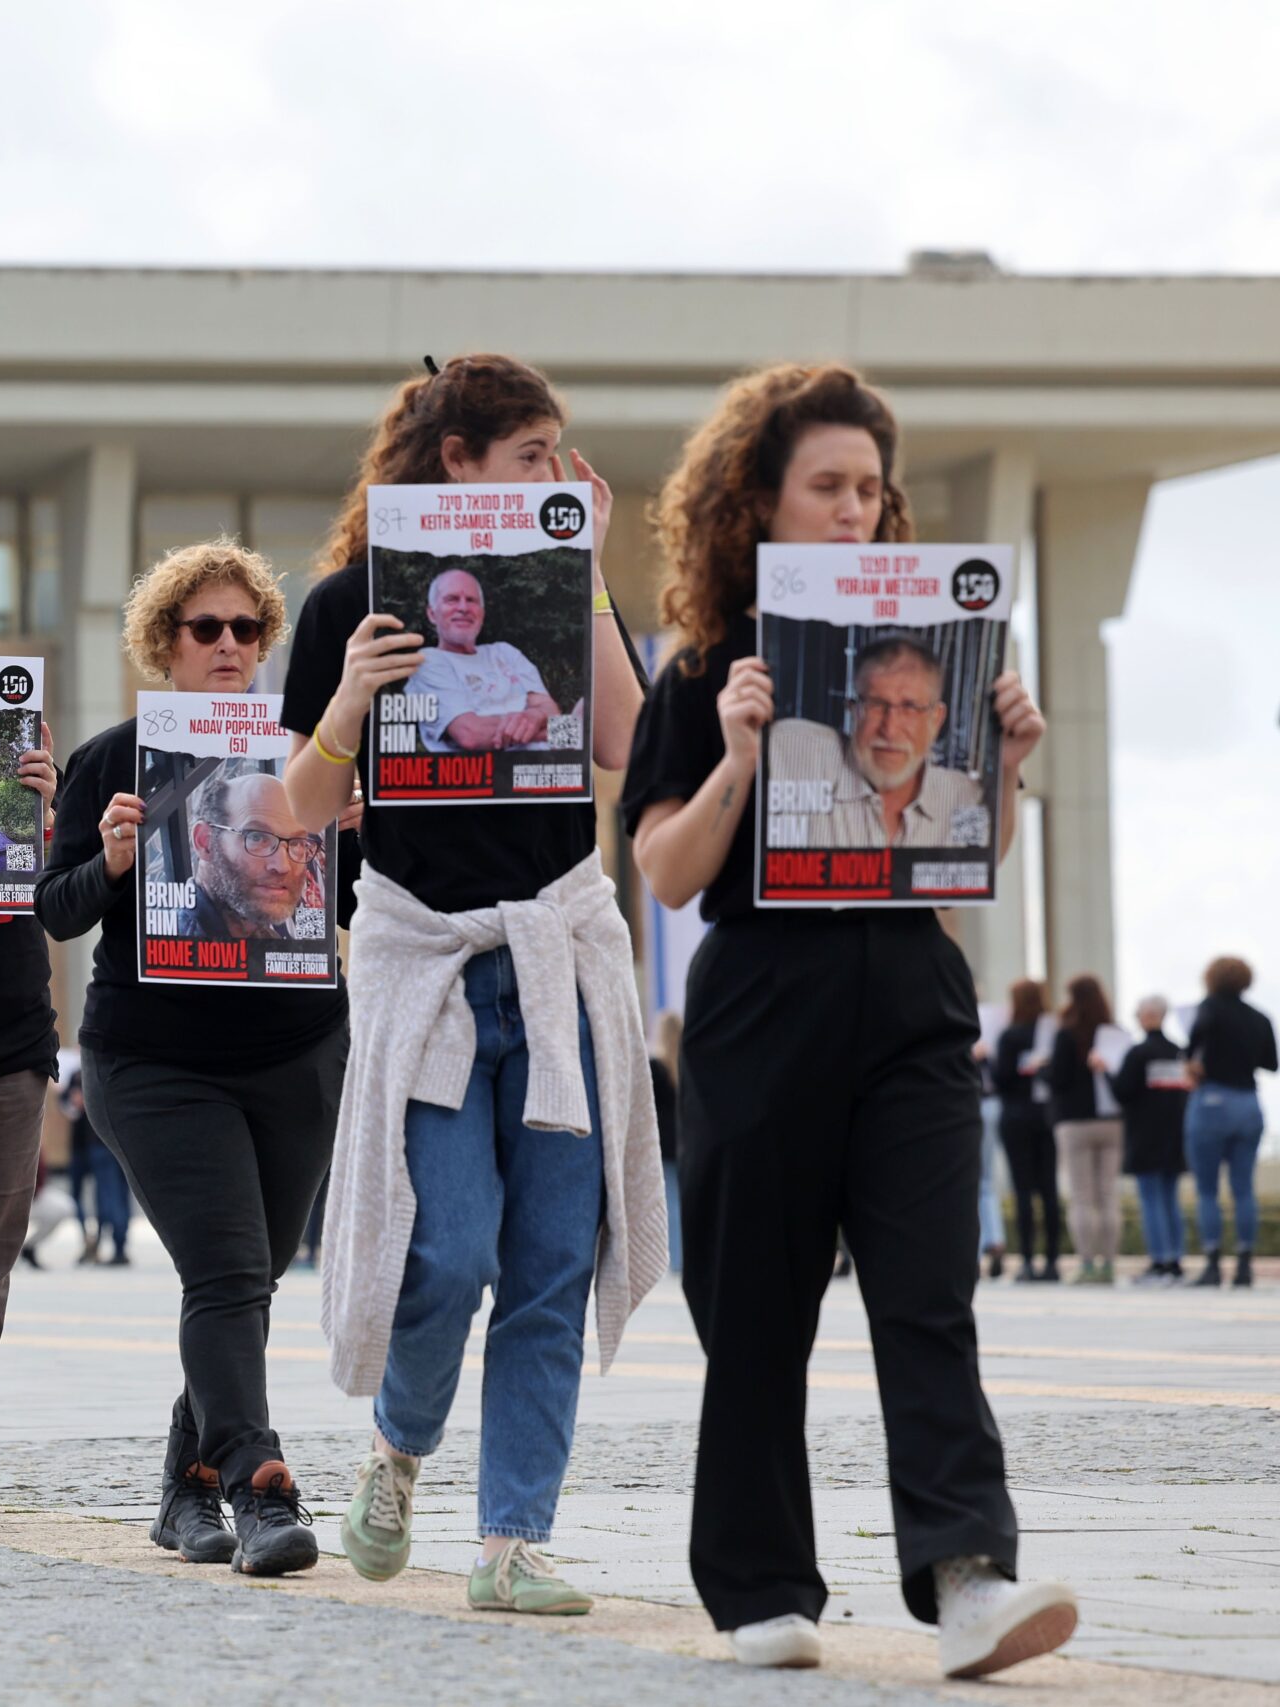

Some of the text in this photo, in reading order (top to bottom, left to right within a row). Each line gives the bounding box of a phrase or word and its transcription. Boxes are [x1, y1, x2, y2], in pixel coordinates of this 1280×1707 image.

[374, 507, 407, 536] 87
[420, 512, 536, 531] KEITH SAMUEL SIEGEL
[547, 506, 580, 532] 150
[470, 531, 494, 551] (64)
[770, 563, 807, 602] 86
[956, 573, 996, 602] 150
[2, 675, 28, 694] 150
[211, 701, 267, 718] נדב פופלוול
[380, 693, 438, 723] BRING
[143, 709, 178, 736] 88
[189, 719, 223, 735] NADAV
[229, 737, 248, 754] (51)
[380, 723, 416, 753] HIM
[380, 752, 494, 786] HOME NOW!
[767, 780, 833, 814] BRING
[767, 814, 808, 848] HIM
[766, 851, 826, 885] HOME
[830, 847, 892, 885] NOW!
[4, 884, 15, 892] AND
[145, 881, 196, 909] BRING
[145, 908, 178, 936] HIM
[146, 939, 247, 969] HOME NOW!
[265, 961, 329, 976] FAMILIES FORUM
